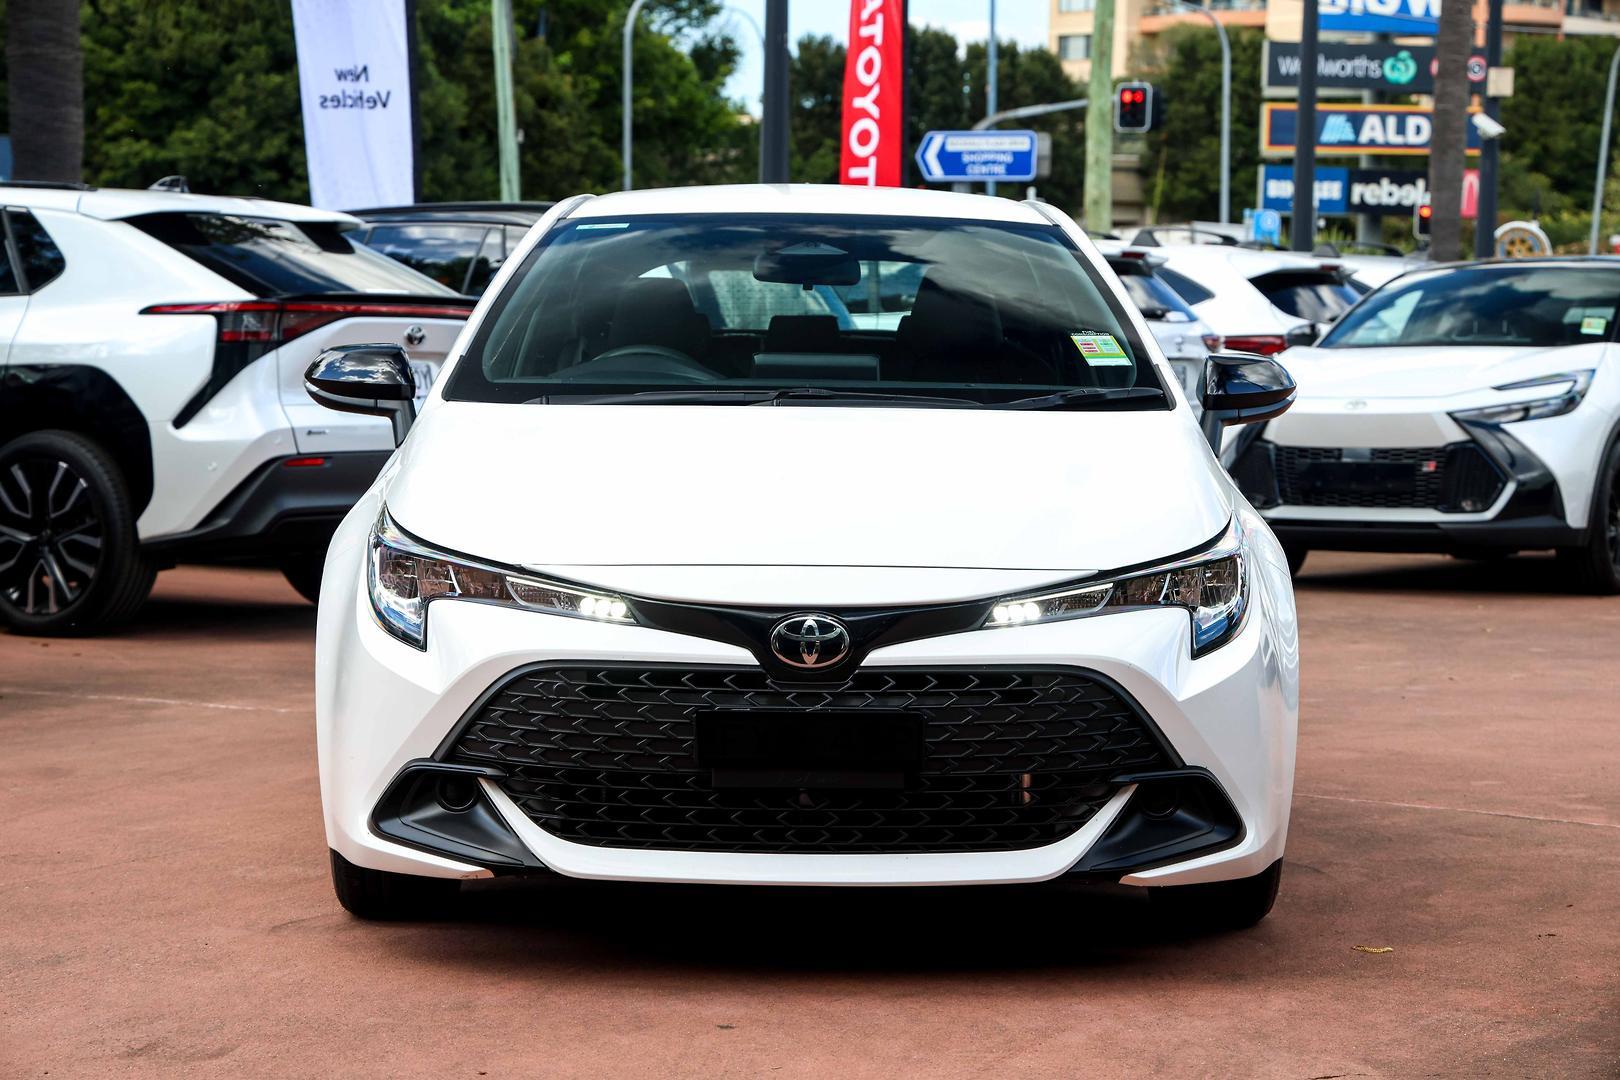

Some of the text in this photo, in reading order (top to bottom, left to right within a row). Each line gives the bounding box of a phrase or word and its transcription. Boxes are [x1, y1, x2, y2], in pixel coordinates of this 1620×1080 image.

[1277, 53, 1382, 79] Wlworths
[1358, 114, 1432, 145] ALD
[1351, 176, 1426, 206] rebel
